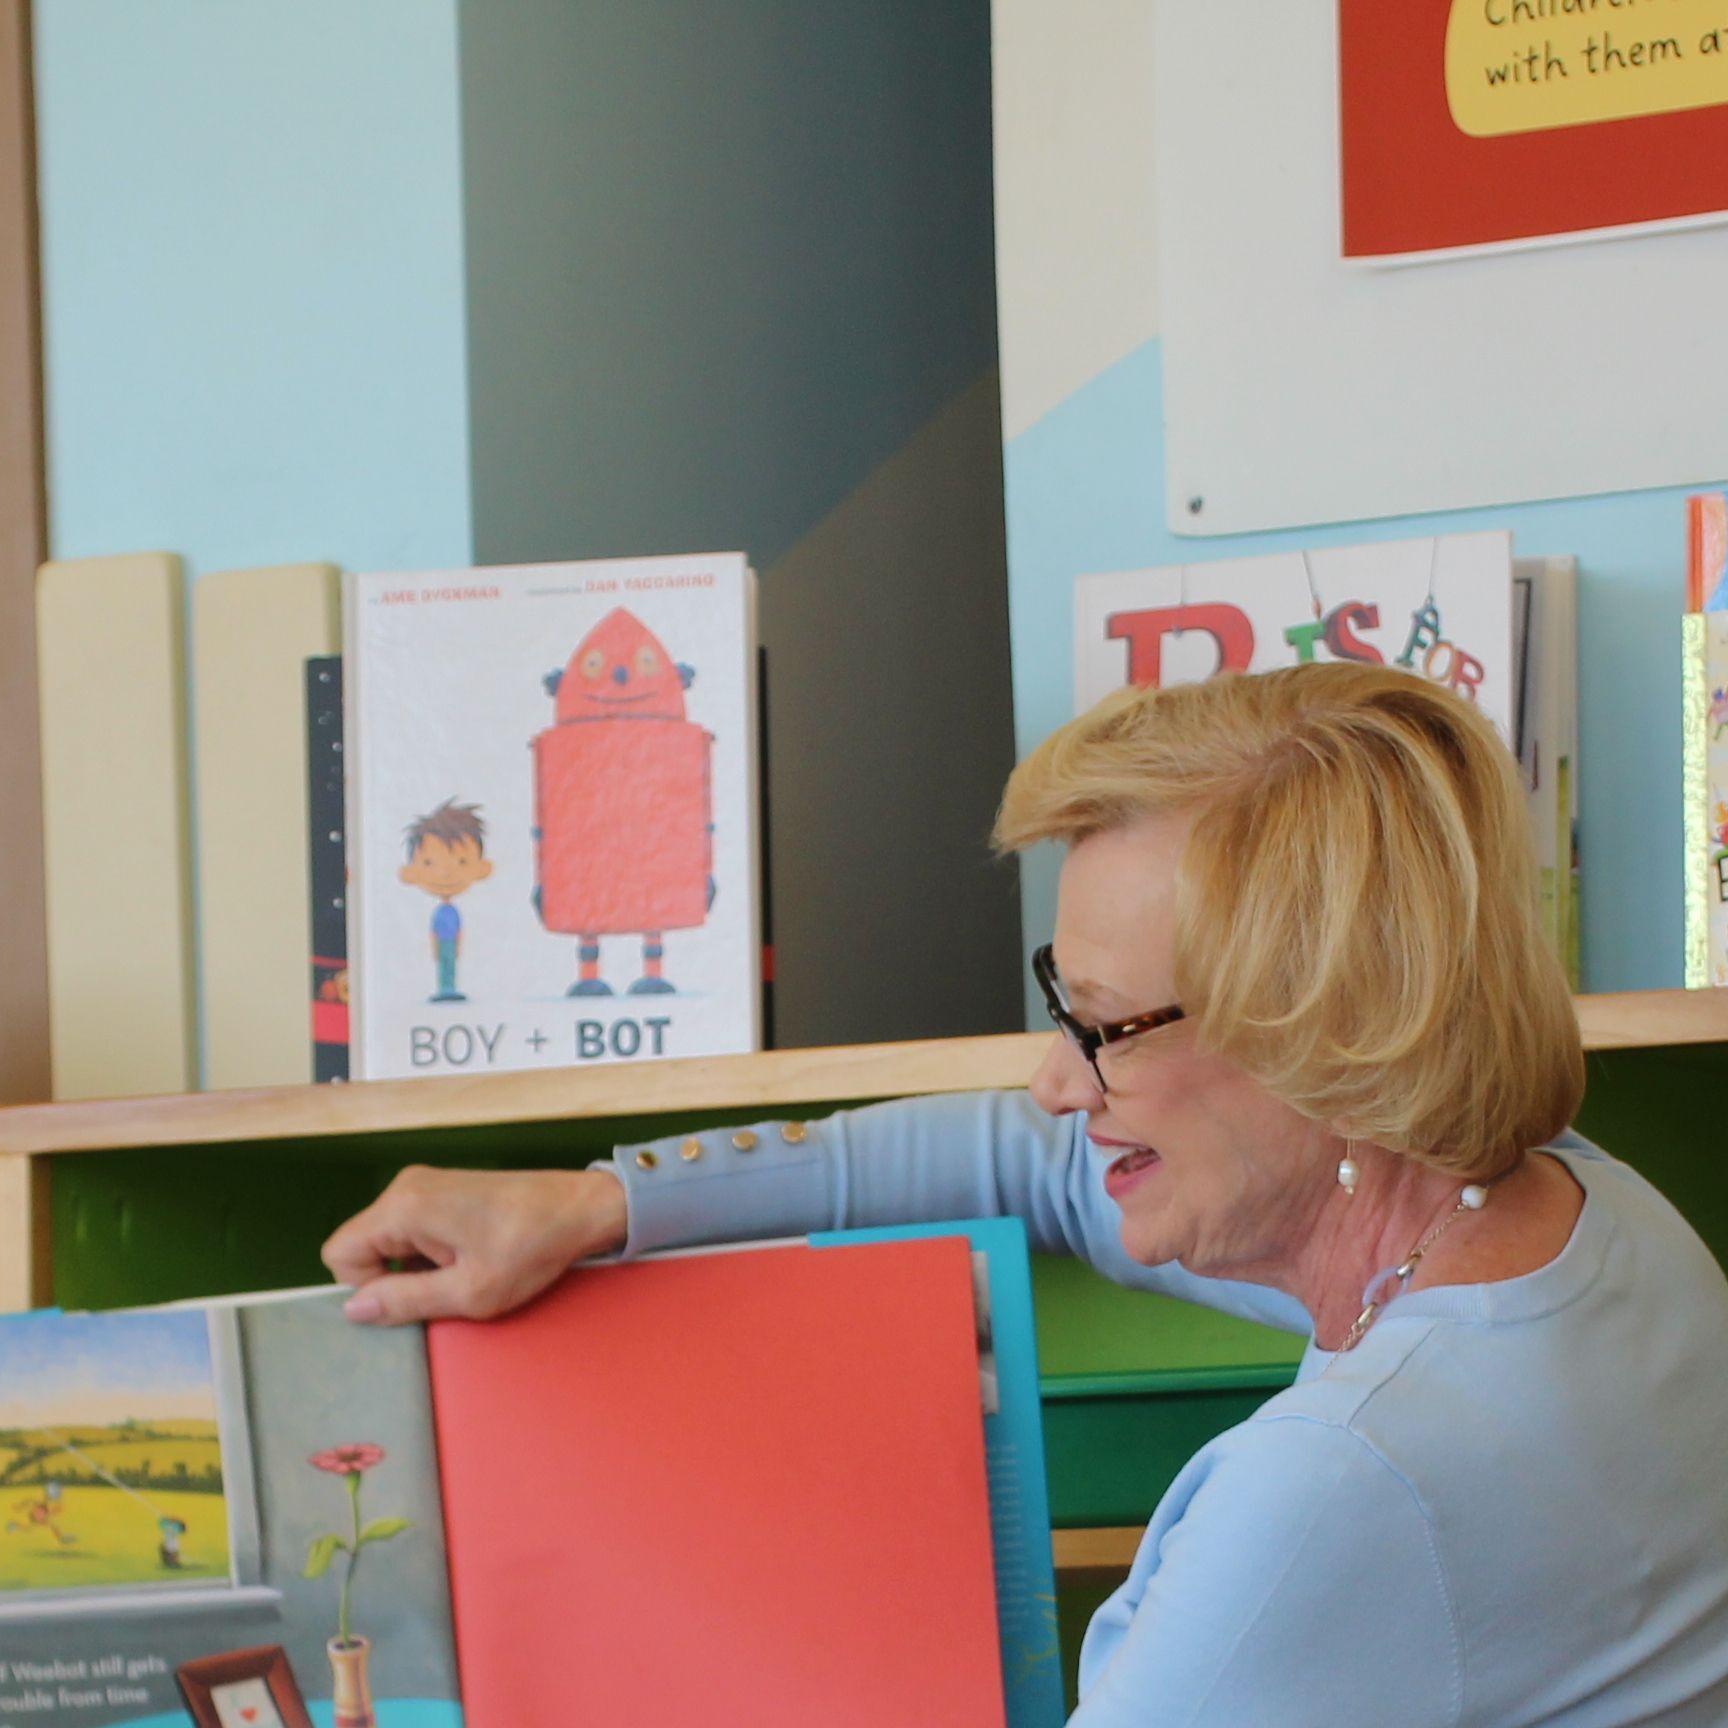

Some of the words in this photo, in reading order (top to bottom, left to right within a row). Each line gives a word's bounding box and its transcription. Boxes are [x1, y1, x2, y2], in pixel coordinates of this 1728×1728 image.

[1485, 41, 1567, 87] with
[1582, 31, 1682, 75] them
[409, 1023, 504, 1067] BOY
[525, 1028, 549, 1055] +
[576, 1017, 671, 1059] BOT
